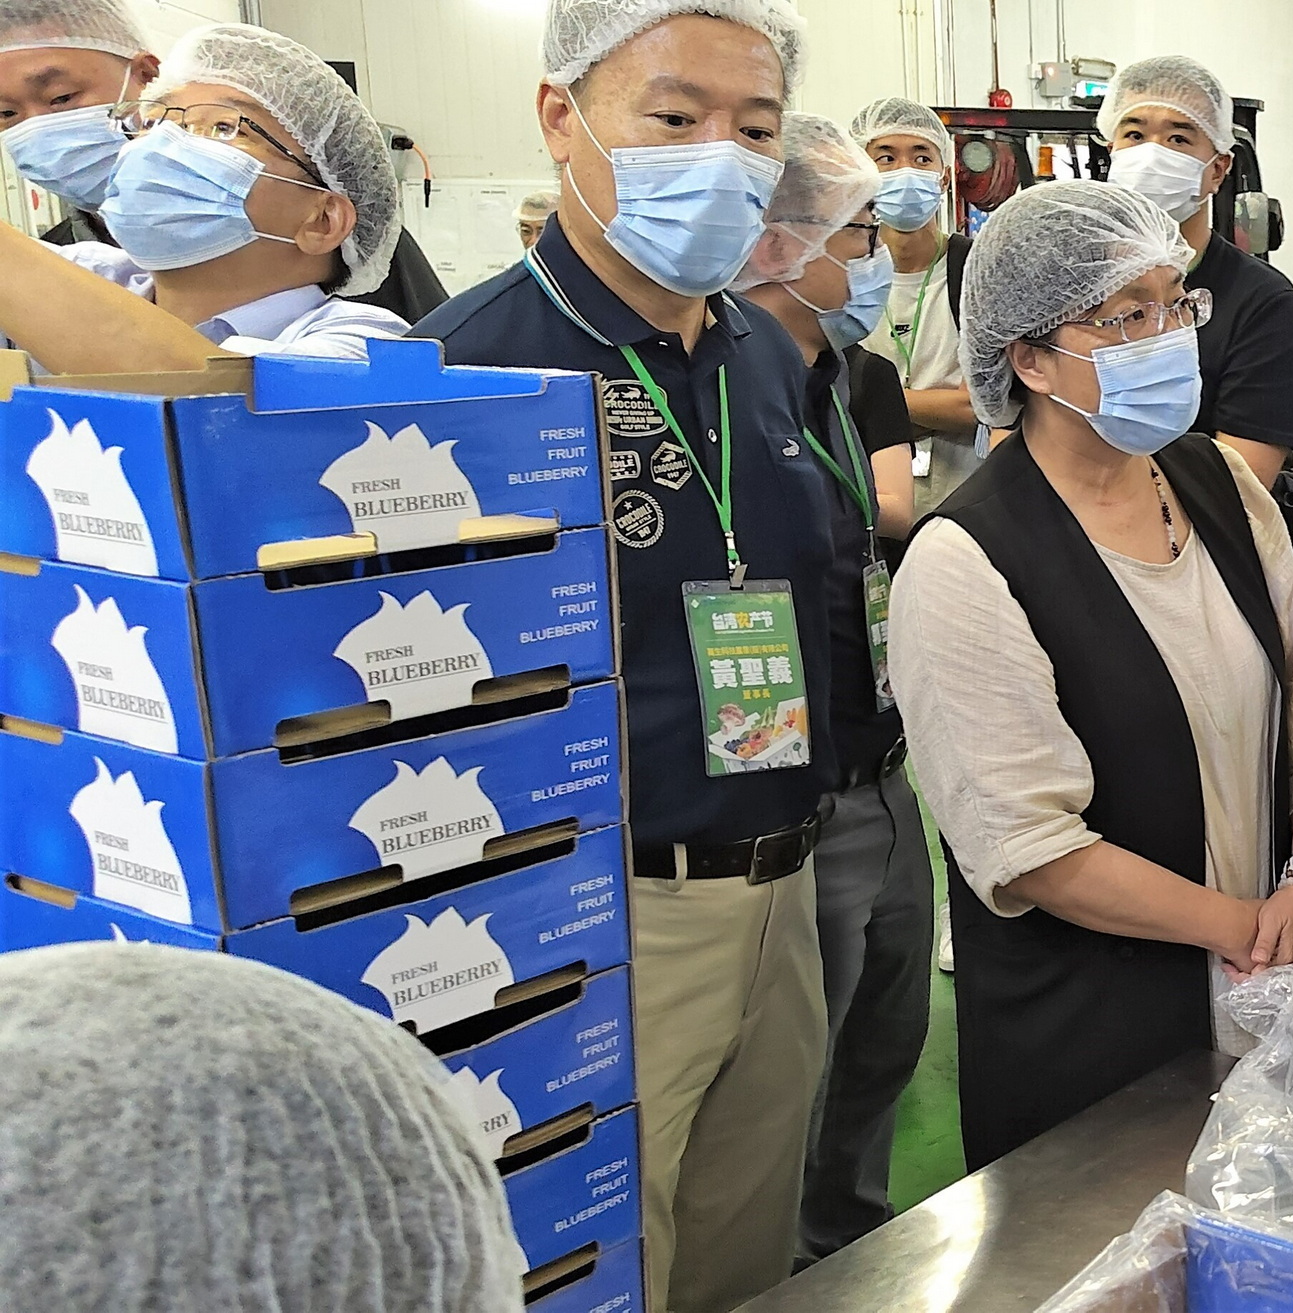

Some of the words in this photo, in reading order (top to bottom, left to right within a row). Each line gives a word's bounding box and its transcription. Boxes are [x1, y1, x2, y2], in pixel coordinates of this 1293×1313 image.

[539, 427, 585, 441] FRESH
[547, 446, 587, 461] FRUIT
[351, 478, 401, 494] FRESH
[507, 465, 588, 486] BLUEBERRY
[53, 488, 90, 506] FRESH
[353, 491, 469, 518] BLUEBERRY
[57, 512, 145, 542] BLUEBERRY
[551, 581, 597, 598] FRESH
[558, 600, 598, 617] FRUIT
[520, 619, 600, 644] BLUEBERRY
[364, 644, 414, 664] FRESH
[77, 661, 114, 681] FRESH
[367, 652, 480, 687] BLUEBERRY
[709, 655, 794, 690] 黃聖義
[80, 684, 166, 720] BLUEBERRY
[563, 736, 608, 756] FRESH
[570, 754, 610, 773] FRUIT
[531, 773, 610, 802] BLUEBERRY
[379, 810, 429, 832] FRESH
[381, 813, 494, 854] BLUEBERRY
[94, 830, 129, 852] FRESH
[97, 852, 181, 892] BLUEBERRY
[570, 874, 614, 896] FRESH
[577, 891, 615, 913] FRUIT
[539, 909, 616, 945] BLUEBERRY
[391, 960, 438, 985] FRESH
[393, 958, 501, 1006] BLUEBERRY
[576, 1018, 618, 1044] FRESH
[582, 1035, 620, 1059] FRUIT
[546, 1052, 620, 1093] BLUEBERRY
[585, 1156, 628, 1184] FRESH
[591, 1173, 629, 1198] FRUIT
[554, 1190, 629, 1233] BLUEBERRY
